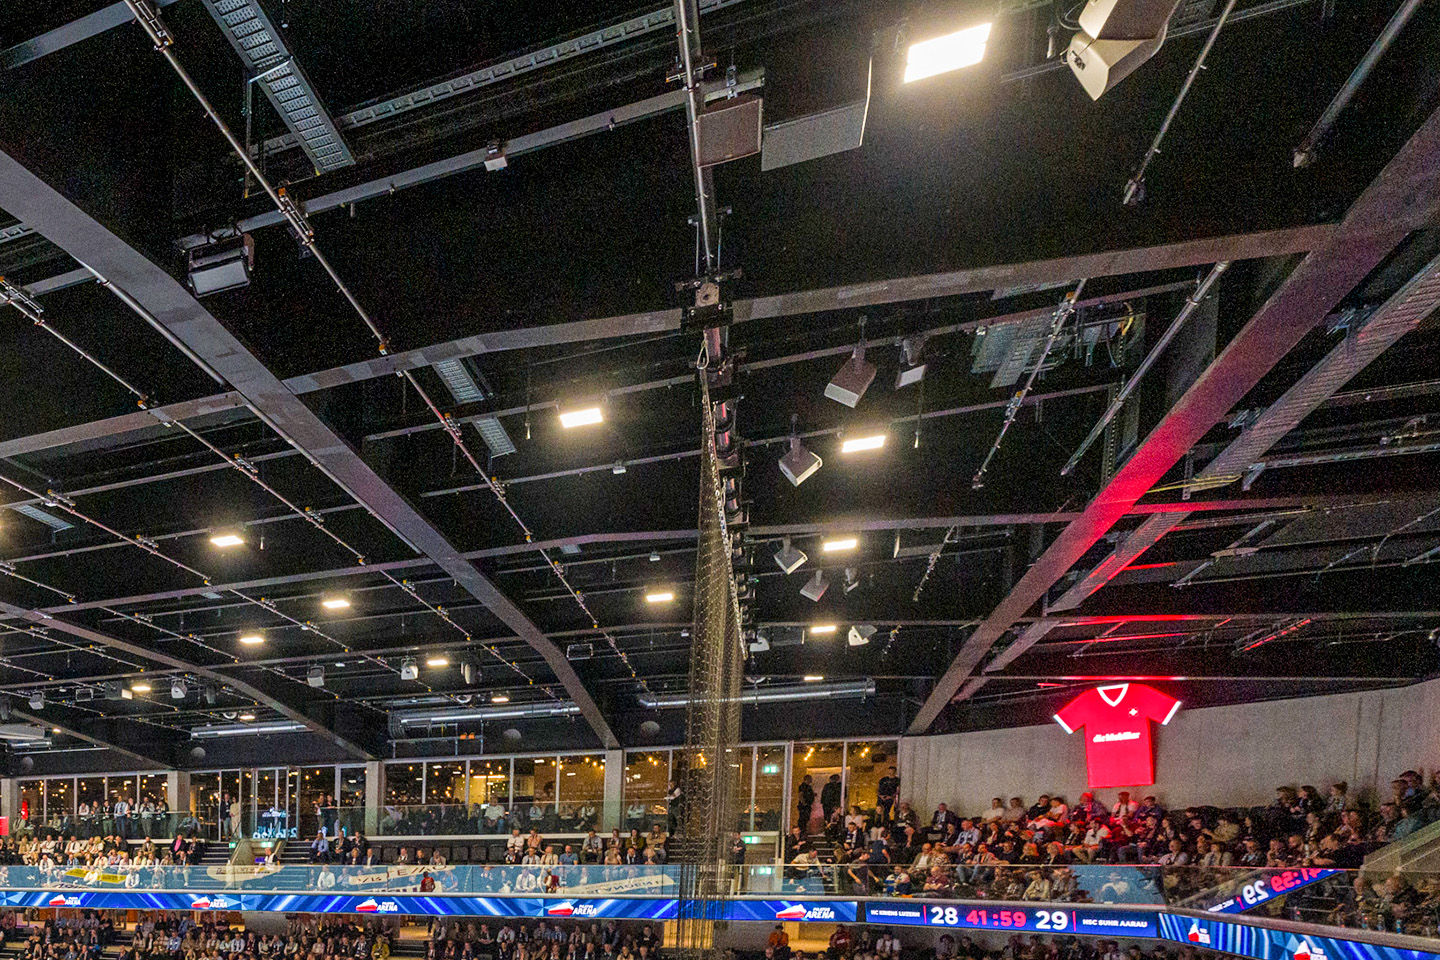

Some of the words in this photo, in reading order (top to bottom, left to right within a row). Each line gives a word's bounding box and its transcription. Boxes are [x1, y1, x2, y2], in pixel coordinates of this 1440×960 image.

[572, 907, 598, 915] ARENA
[804, 911, 835, 919] ARENA
[931, 906, 959, 924] 28
[966, 909, 1027, 928] 41:59
[1035, 910, 1068, 930] 29
[1098, 919, 1119, 927] SUHR
[1119, 920, 1148, 928] AARAU
